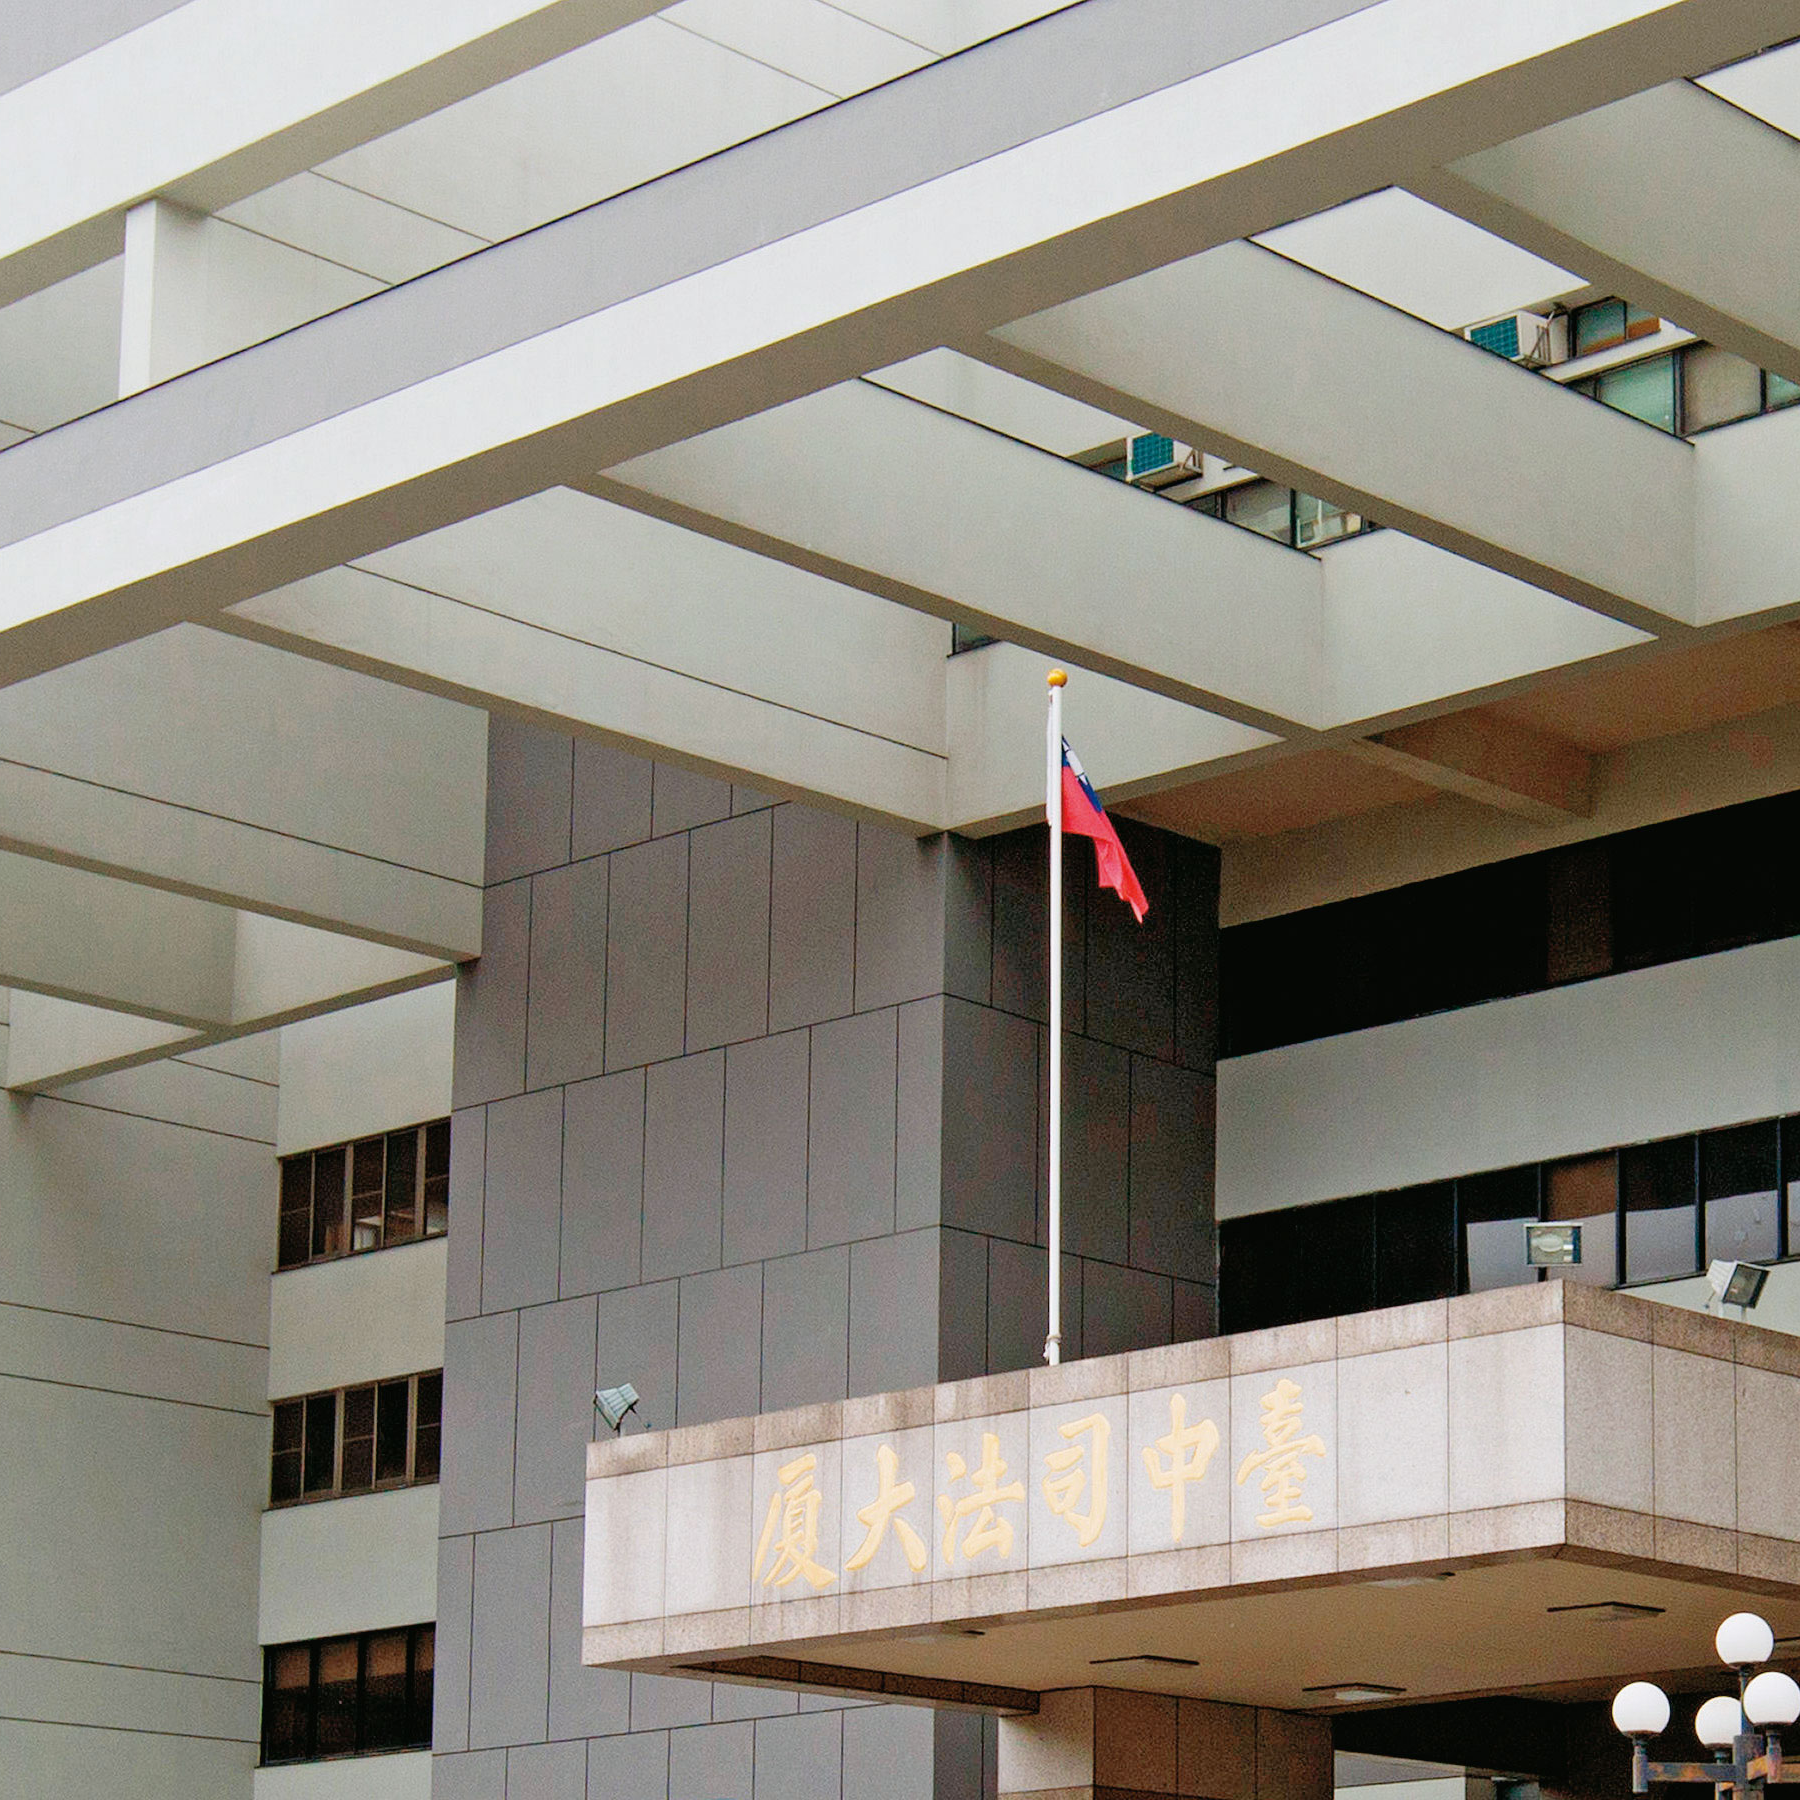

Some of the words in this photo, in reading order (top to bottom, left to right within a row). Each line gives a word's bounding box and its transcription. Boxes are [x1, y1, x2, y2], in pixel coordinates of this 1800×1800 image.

[753, 1378, 1326, 1590] 臺中司法大廈
